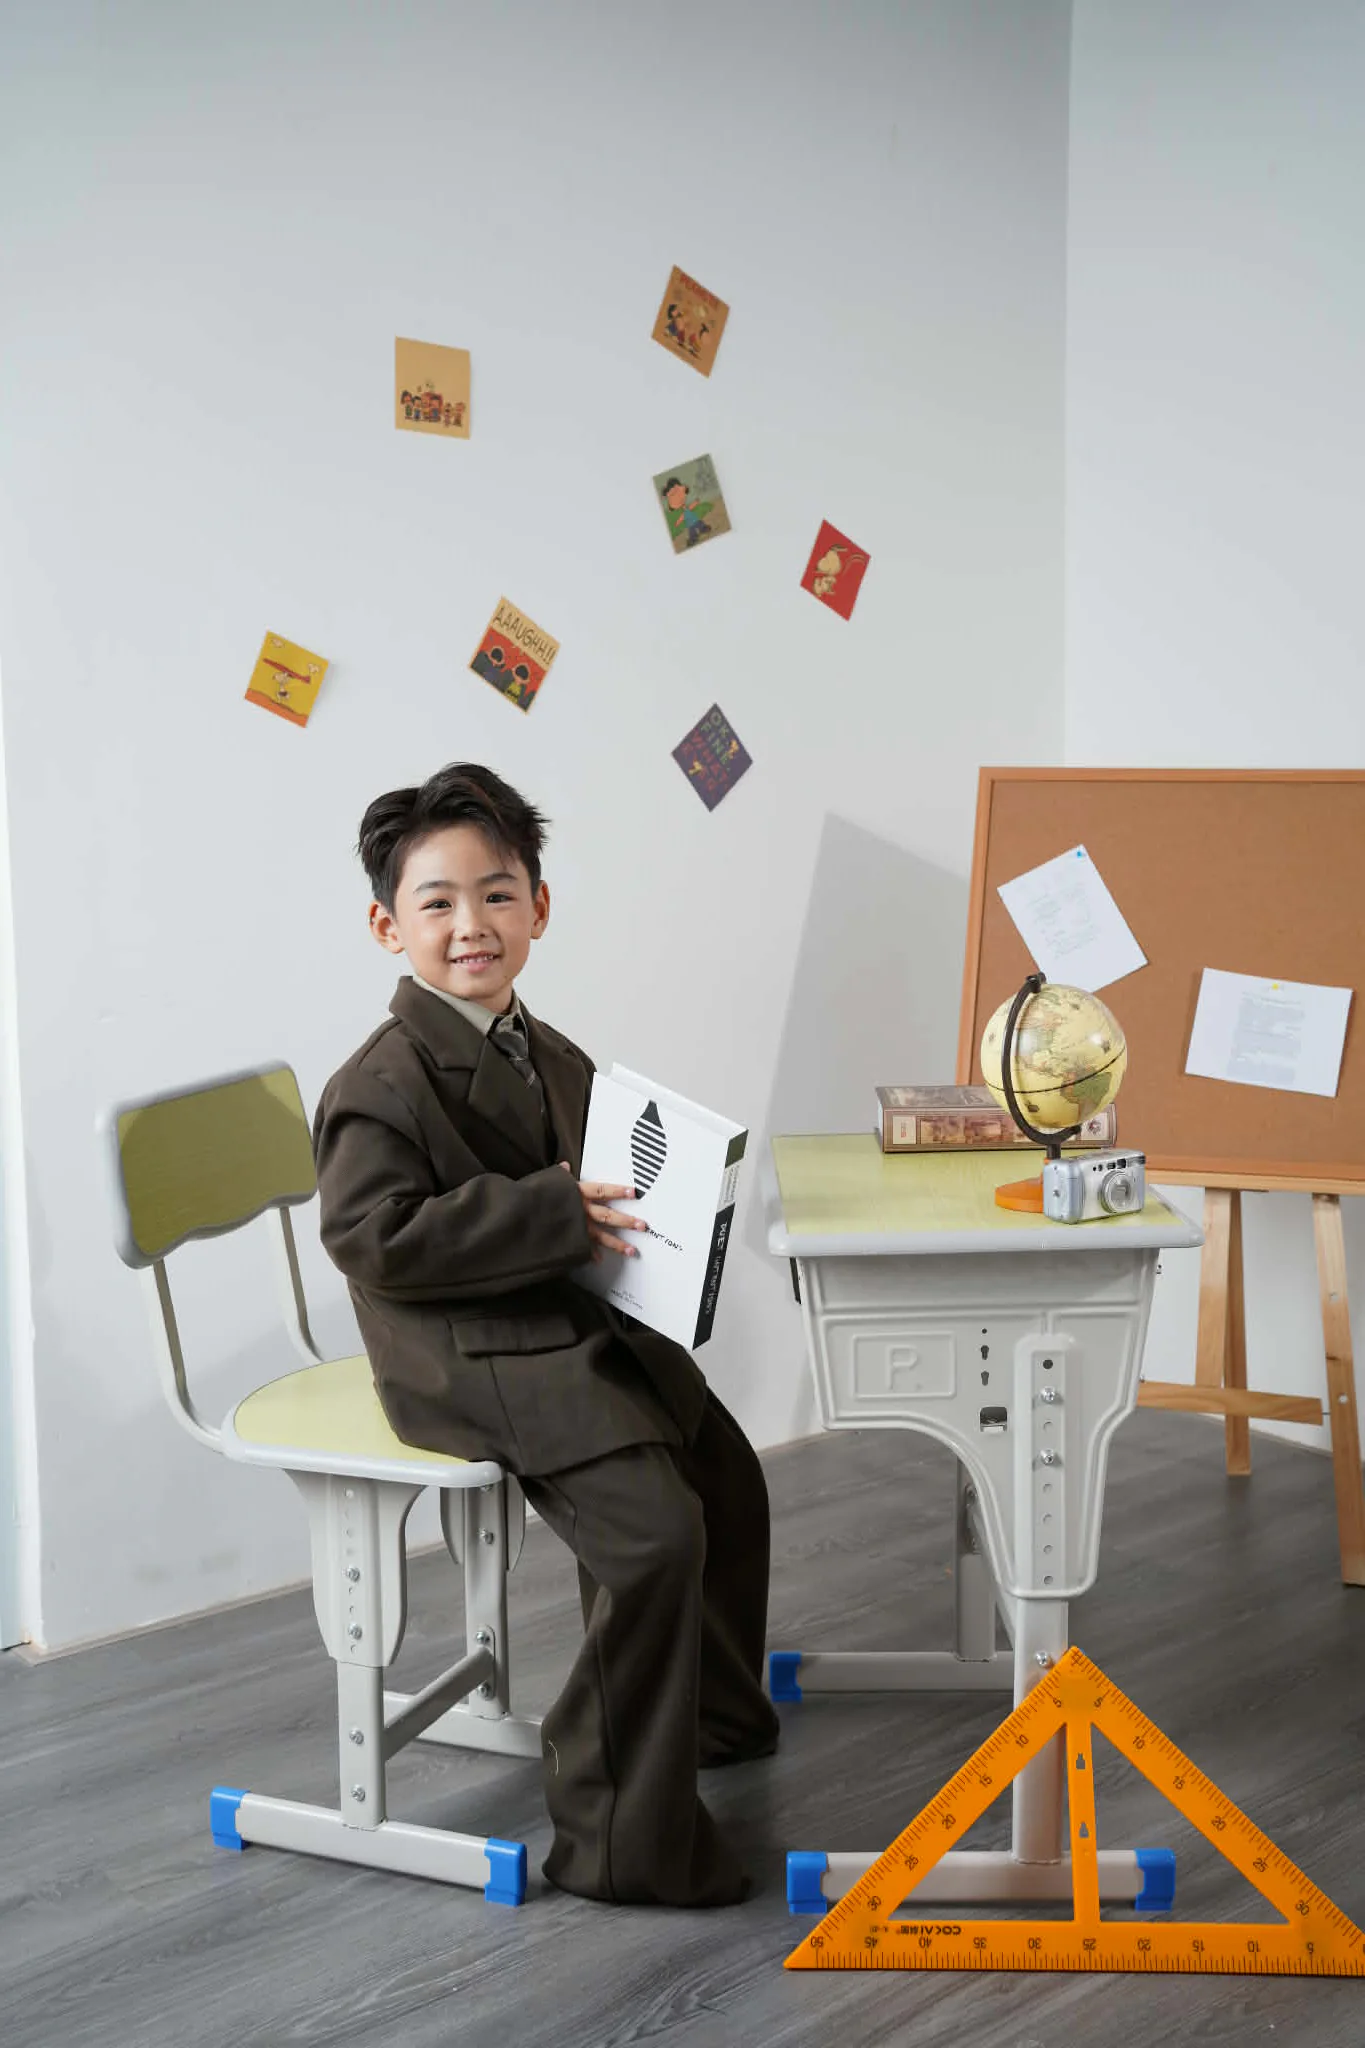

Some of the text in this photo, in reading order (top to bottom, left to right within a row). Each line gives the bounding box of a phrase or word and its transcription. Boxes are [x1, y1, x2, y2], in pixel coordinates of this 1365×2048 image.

[1052, 1697, 1062, 1708] 5
[1094, 1696, 1104, 1708] 5
[1015, 1734, 1029, 1748] 10
[1132, 1735, 1145, 1750] 10
[979, 1774, 993, 1788] 15
[1173, 1775, 1185, 1790] 15
[941, 1814, 957, 1830] 20
[1211, 1815, 1226, 1831] 20
[904, 1854, 919, 1871] 25
[1252, 1857, 1268, 1873] 25
[810, 1936, 824, 1948] 50
[864, 1936, 878, 1948] 45
[918, 1936, 932, 1948] 40
[973, 1937, 987, 1949] 35
[1027, 1937, 1042, 1949] 30
[1083, 1938, 1097, 1950] 25
[1137, 1939, 1151, 1951] 20
[1192, 1940, 1205, 1952] 15
[1247, 1941, 1261, 1953] 10
[1306, 1942, 1314, 1953] 5
